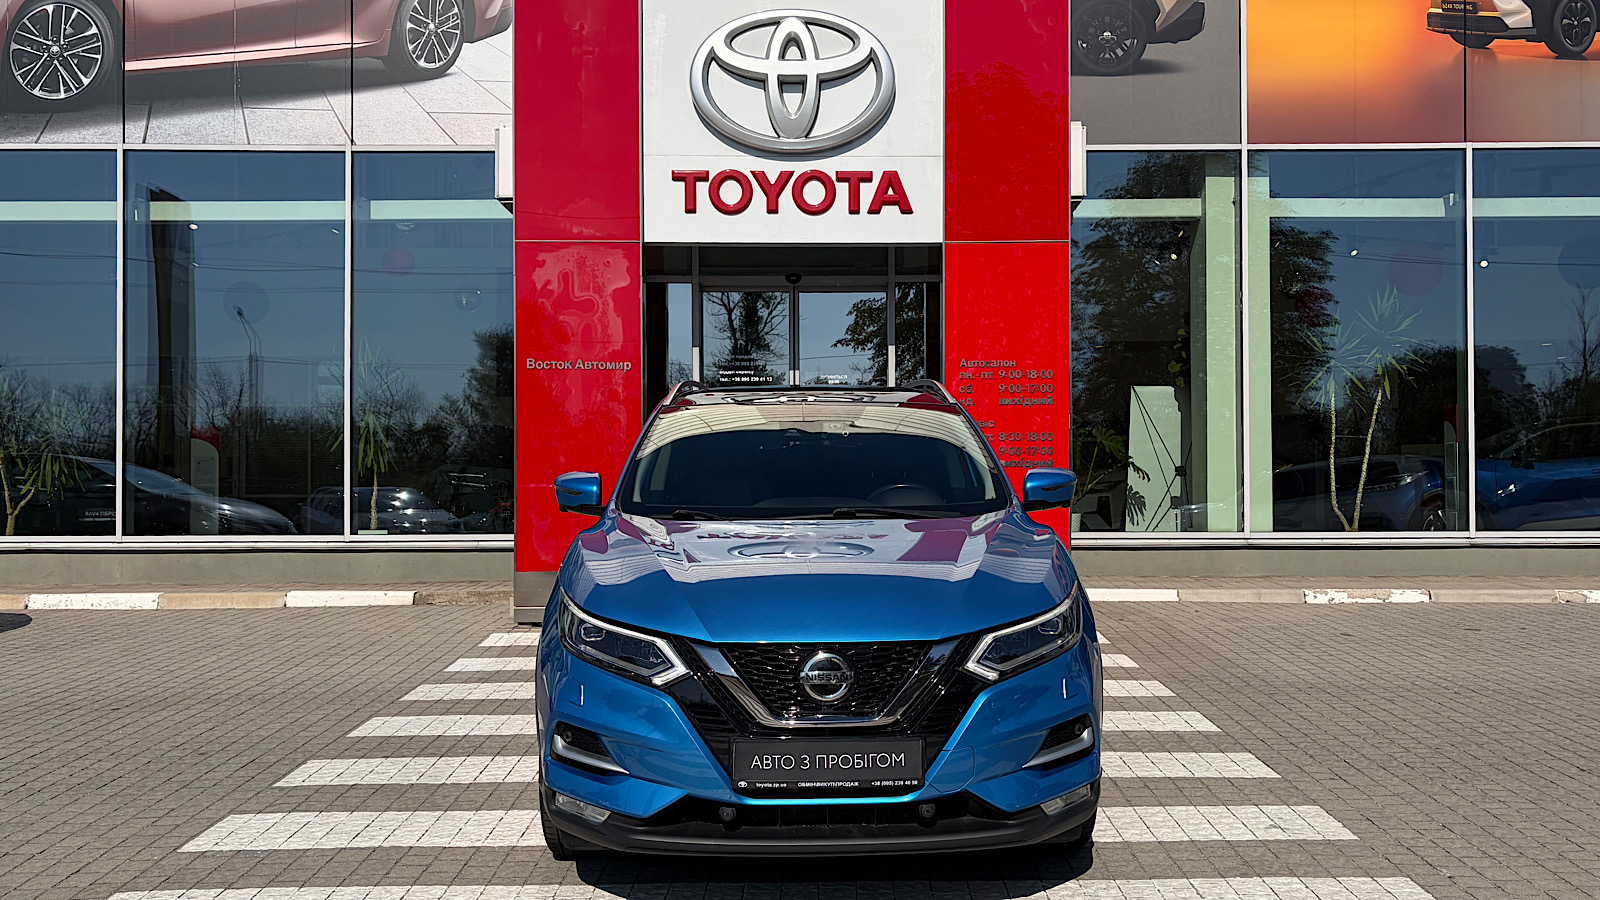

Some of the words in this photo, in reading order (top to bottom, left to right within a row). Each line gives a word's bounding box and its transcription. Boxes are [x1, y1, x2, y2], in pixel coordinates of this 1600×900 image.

[1453, 3, 1473, 11] TOURNG
[671, 169, 914, 216] TOYOTA
[526, 358, 573, 370] Восток
[575, 359, 632, 373] Автомир
[959, 358, 1017, 368] Автосалон
[998, 370, 1054, 379] 9:00-18:00
[959, 384, 975, 393] сб.
[998, 384, 1054, 393] 9:00-17:00
[998, 396, 1054, 406] вихідний
[998, 432, 1054, 441] 8:30-18:00
[998, 446, 1054, 456] 9:00-17:00
[805, 673, 849, 681] NISSAN
[750, 755, 795, 769] АВТО
[816, 753, 905, 769] ПРОБІГОМ
